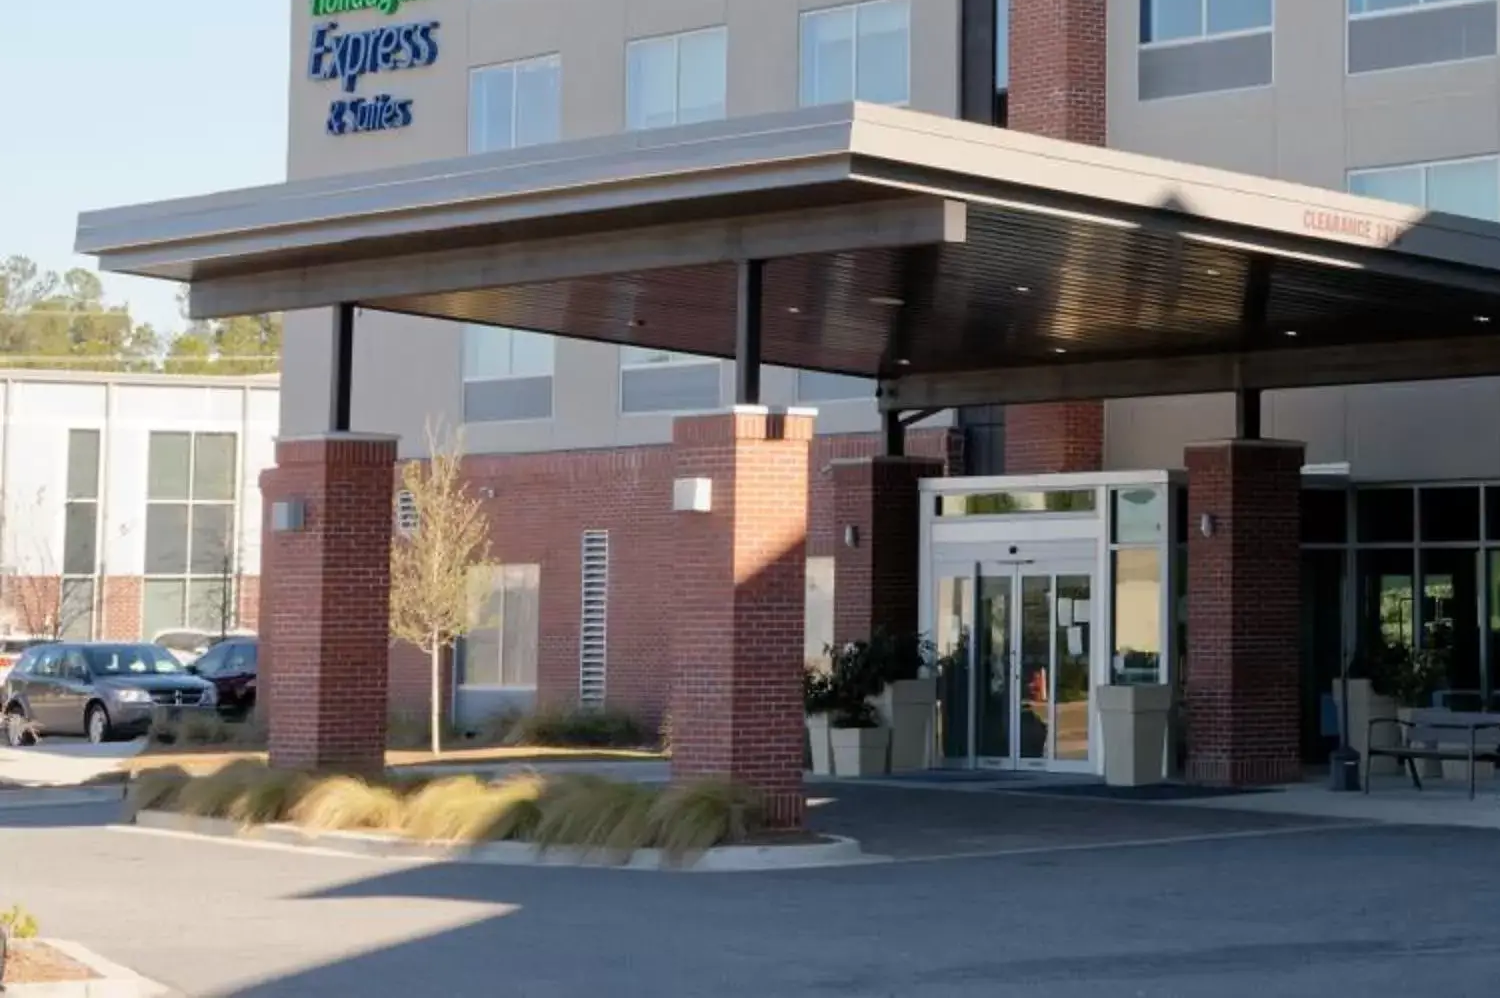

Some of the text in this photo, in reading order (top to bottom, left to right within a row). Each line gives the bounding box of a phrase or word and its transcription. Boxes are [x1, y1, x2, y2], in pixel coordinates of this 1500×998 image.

[308, 21, 440, 92] Express
[326, 93, 413, 135] & Suites
[1303, 209, 1372, 239] CLEARANCE
